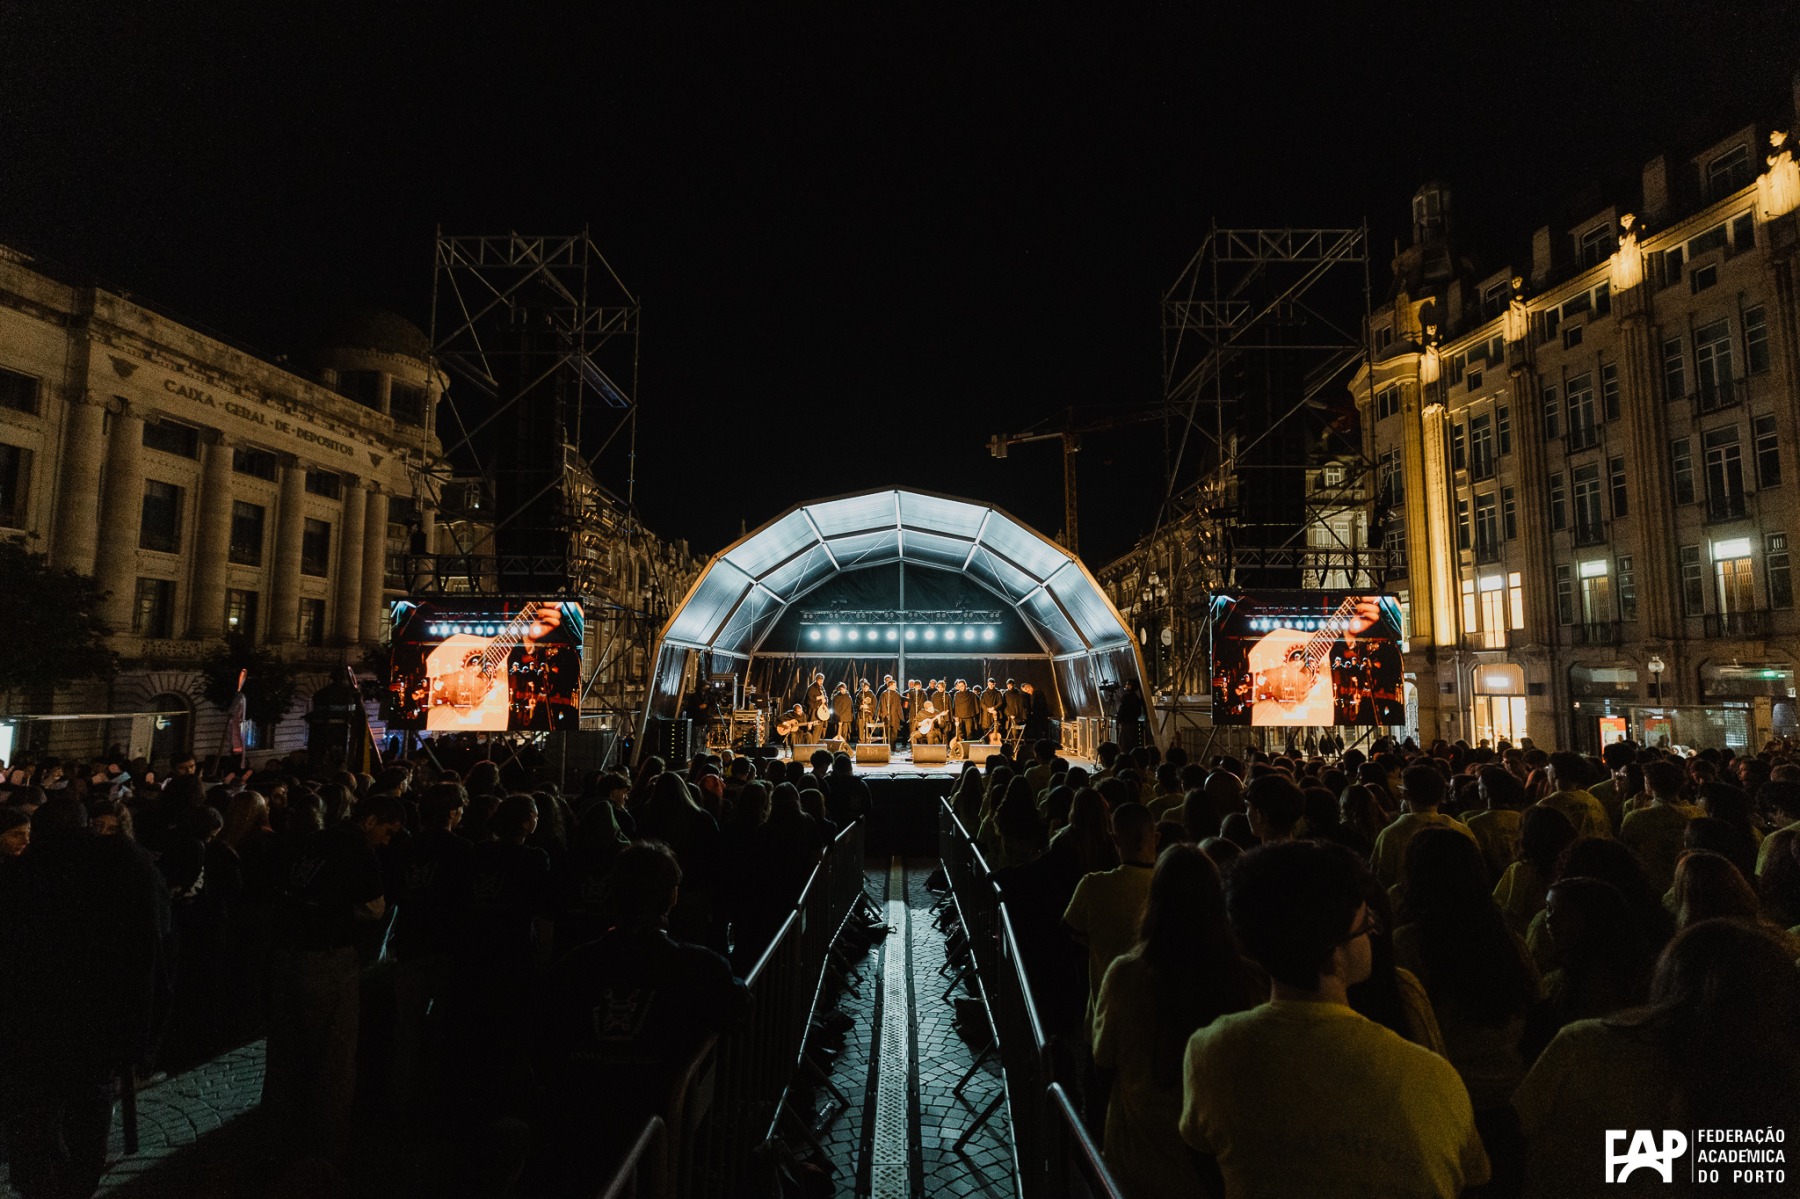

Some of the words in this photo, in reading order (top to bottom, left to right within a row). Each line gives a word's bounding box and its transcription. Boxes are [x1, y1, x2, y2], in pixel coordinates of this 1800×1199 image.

[164, 379, 216, 408] CAIXA
[224, 401, 268, 427] GERAL
[275, 419, 290, 434] DE
